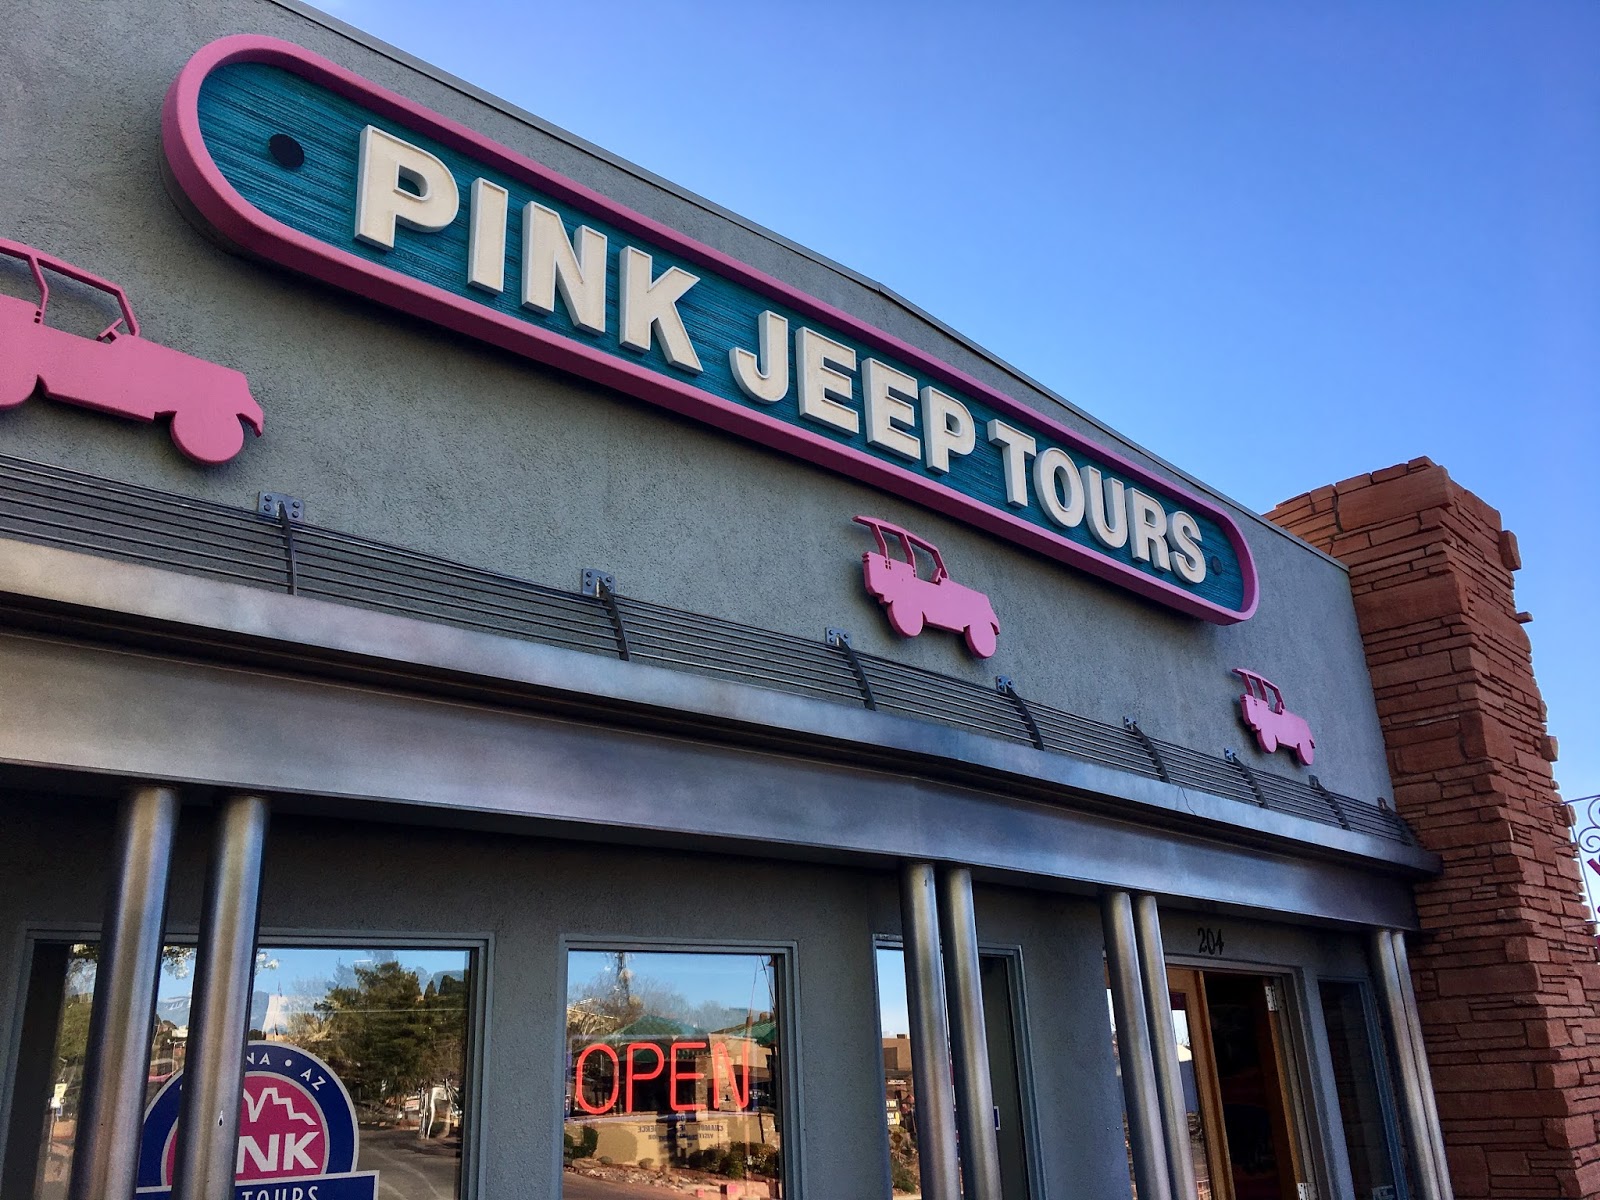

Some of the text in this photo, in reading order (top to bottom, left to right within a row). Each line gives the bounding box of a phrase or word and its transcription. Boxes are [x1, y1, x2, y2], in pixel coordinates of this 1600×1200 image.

[354, 124, 1206, 585] PINK JEEP TOURS
[1197, 927, 1225, 955] 204
[300, 1068, 326, 1091] AZ
[576, 1042, 749, 1115] OPEN
[236, 1131, 320, 1174] NK
